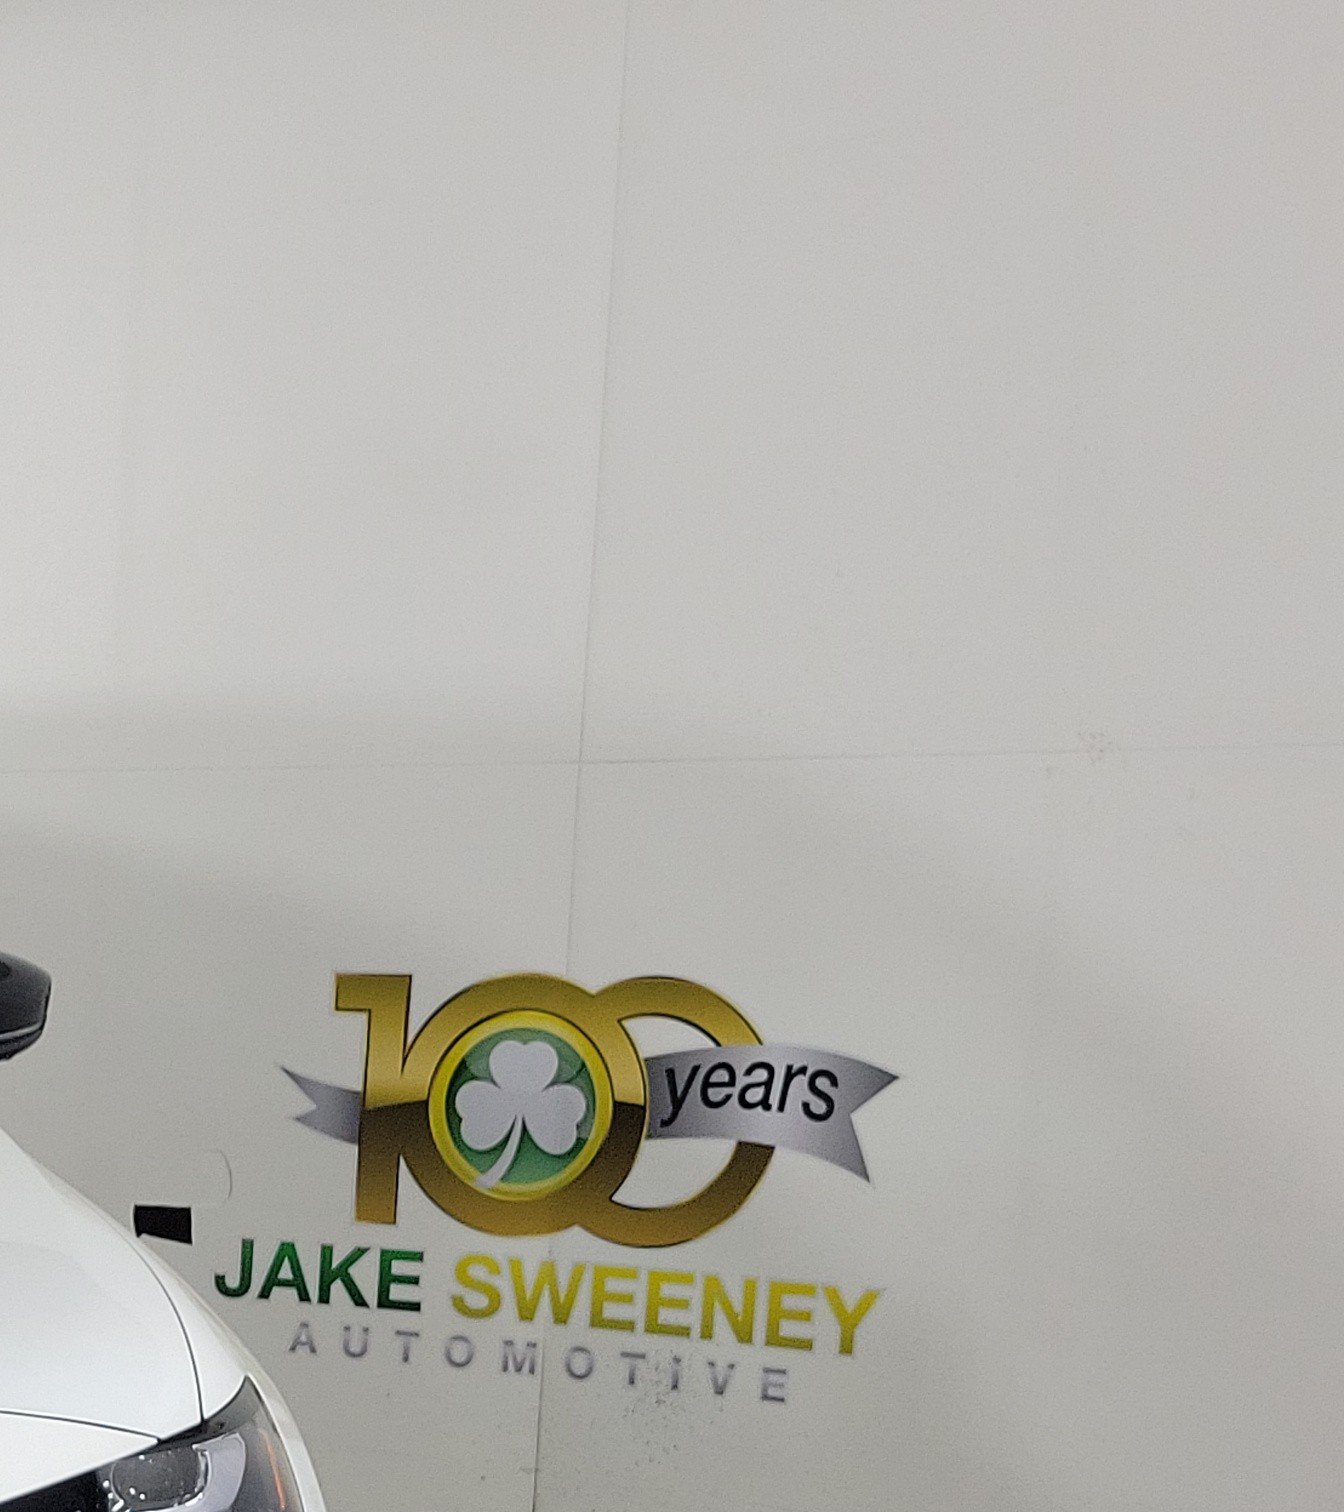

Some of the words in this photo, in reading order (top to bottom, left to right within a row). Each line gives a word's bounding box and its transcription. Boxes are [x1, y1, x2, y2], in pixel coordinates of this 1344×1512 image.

[333, 971, 777, 1249] 100
[659, 1058, 841, 1129] years
[213, 1237, 424, 1312] JAKE
[450, 1253, 880, 1356] SWEENEY
[288, 1321, 789, 1403] AUTOMOTIVE
